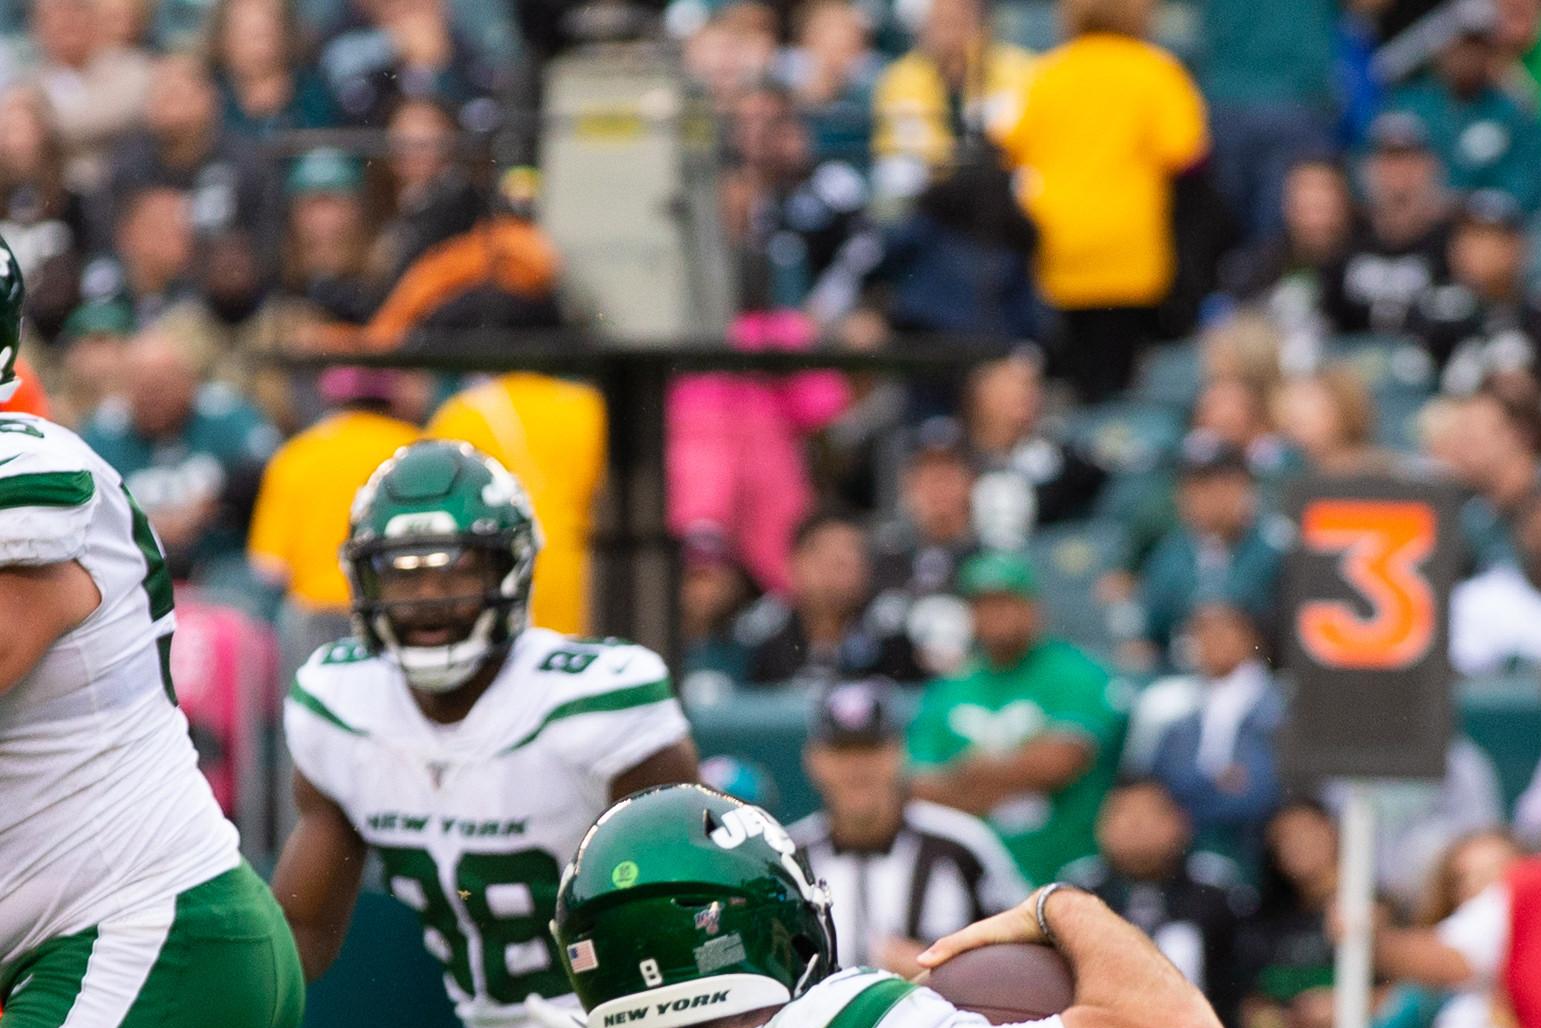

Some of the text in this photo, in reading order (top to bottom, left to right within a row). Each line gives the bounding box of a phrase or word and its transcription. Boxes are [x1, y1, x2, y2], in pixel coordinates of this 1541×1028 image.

[1298, 499, 1437, 671] 3
[375, 845, 568, 1005] 88
[640, 958, 663, 987] 8
[604, 989, 732, 1028] NEW YORK
